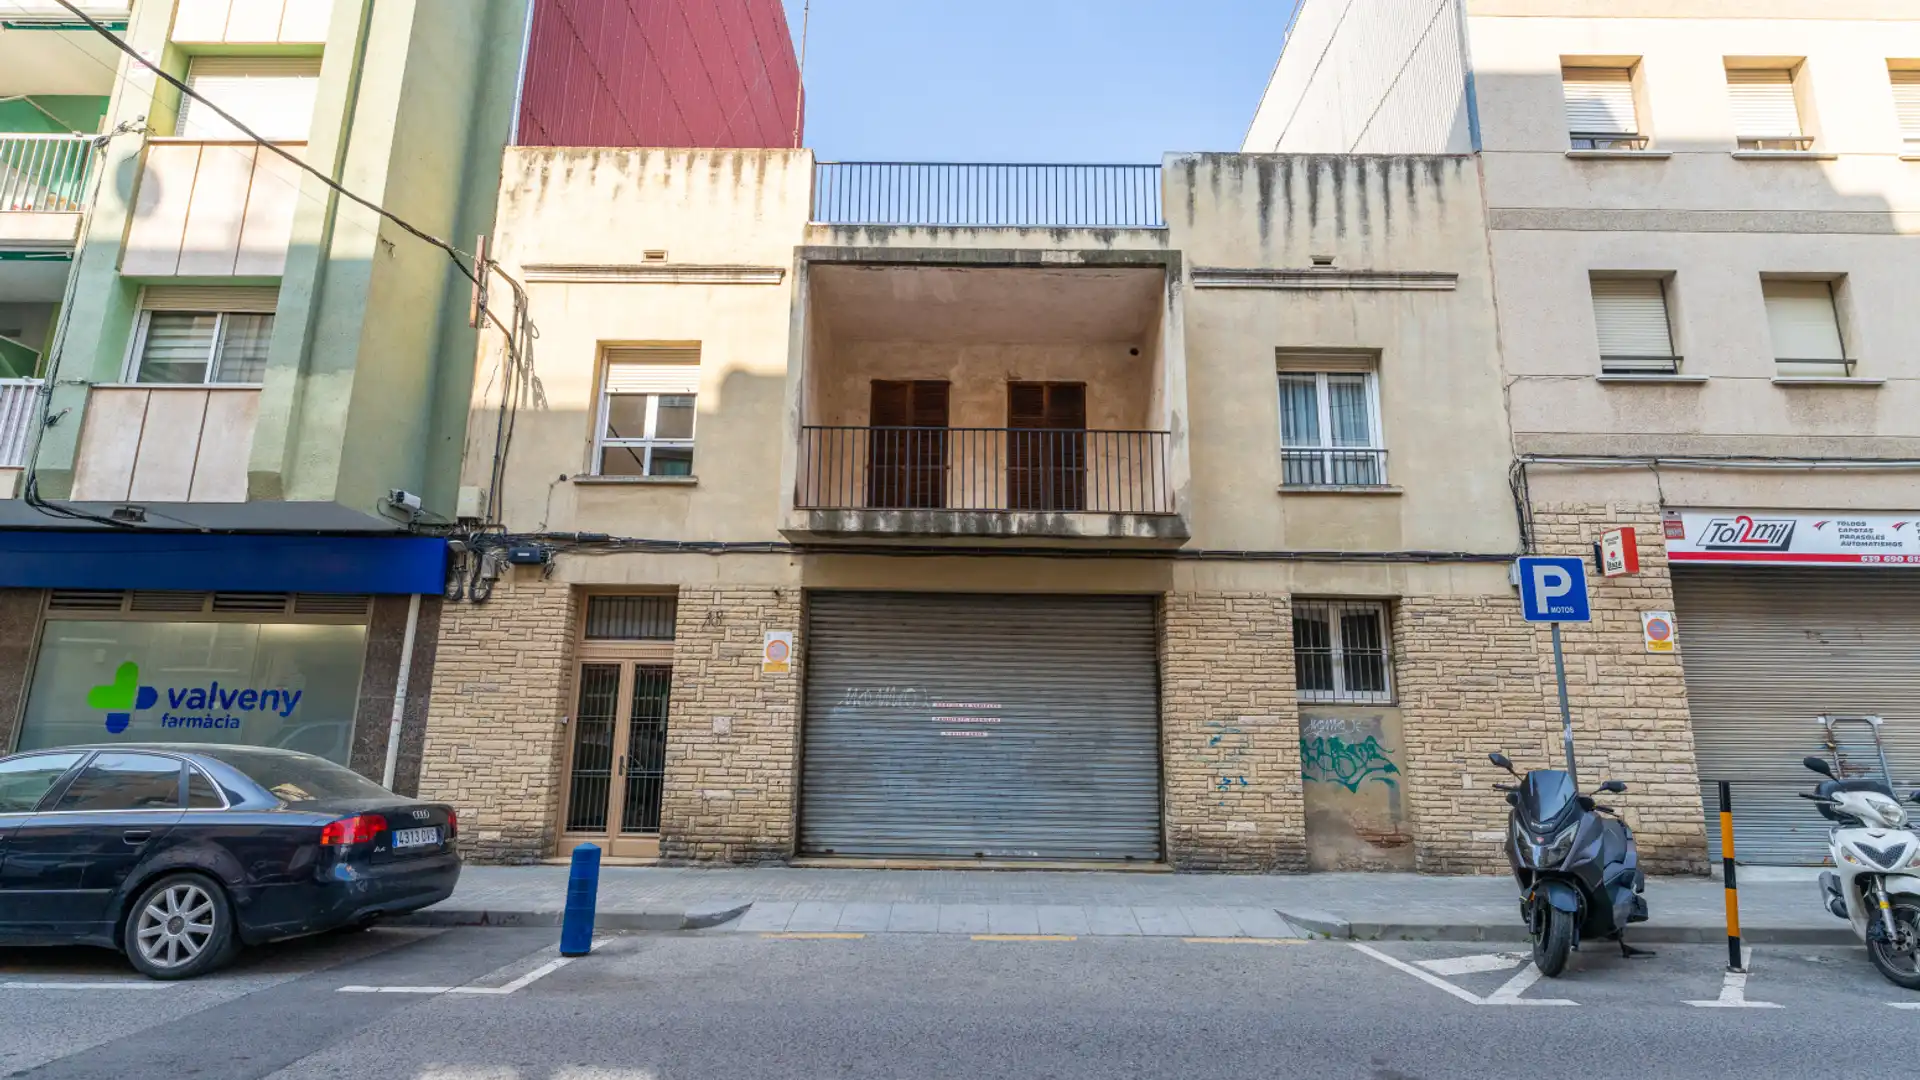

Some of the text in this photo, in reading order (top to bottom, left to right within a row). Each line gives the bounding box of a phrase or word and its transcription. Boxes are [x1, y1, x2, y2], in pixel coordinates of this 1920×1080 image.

[1708, 515, 1789, 543] Tol2mil
[1532, 565, 1572, 614] P
[1550, 606, 1575, 614] MOTOS
[167, 681, 302, 718] valveny
[161, 713, 240, 729] farmàcia
[398, 830, 420, 845] 4313
